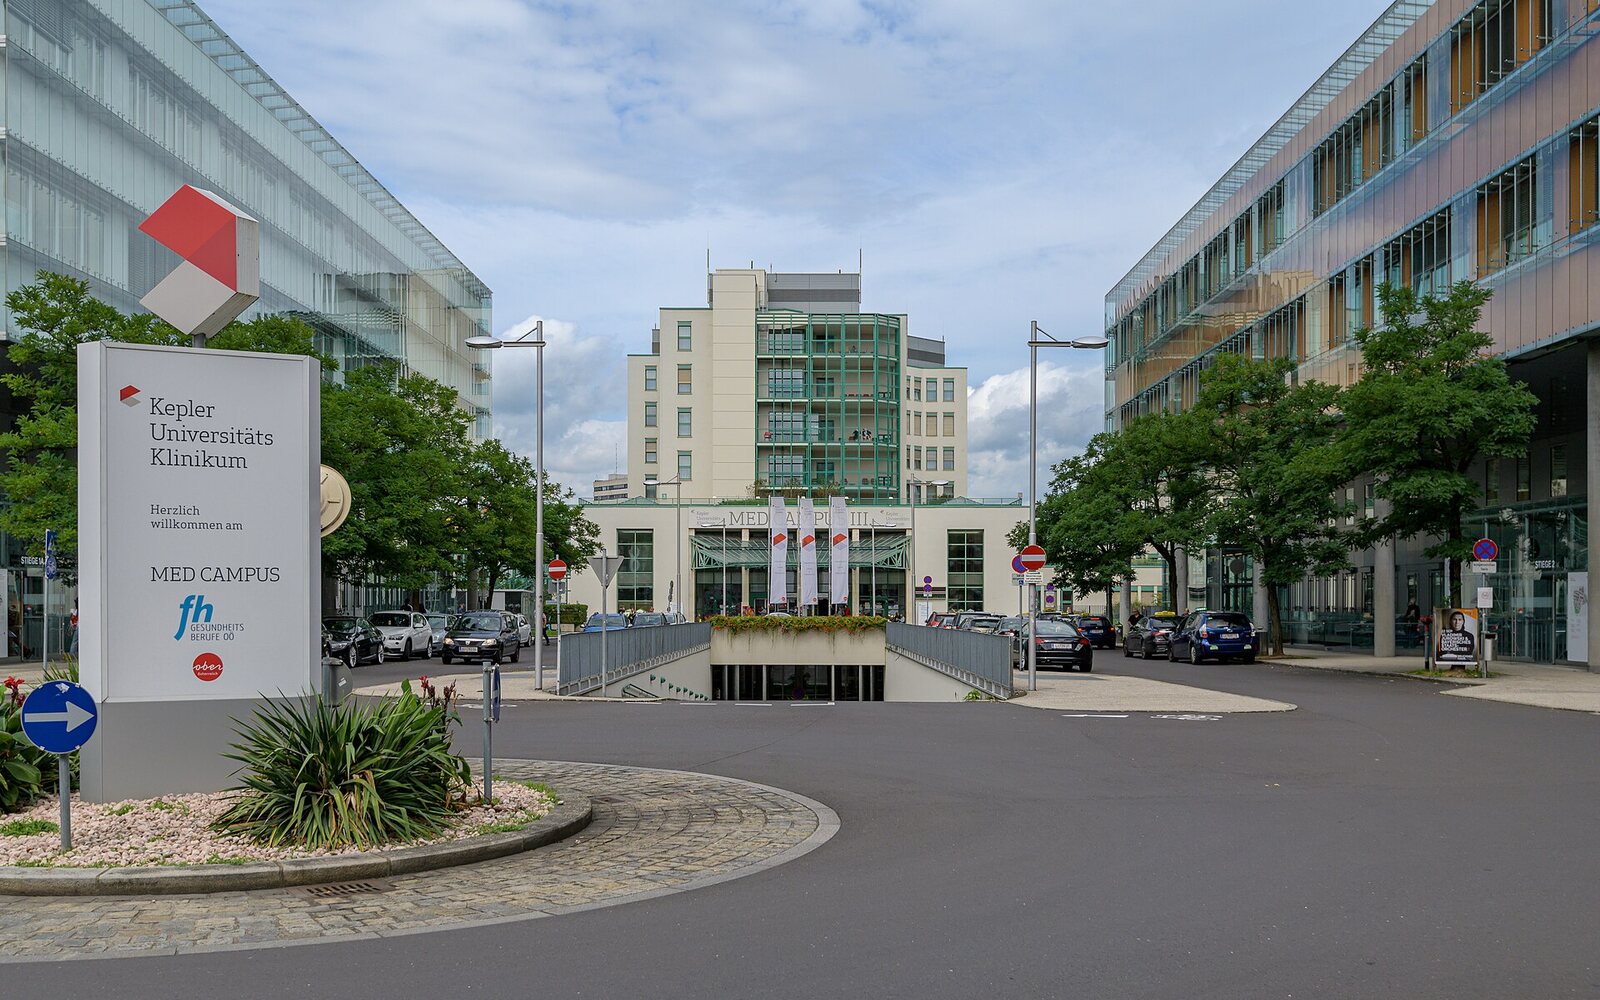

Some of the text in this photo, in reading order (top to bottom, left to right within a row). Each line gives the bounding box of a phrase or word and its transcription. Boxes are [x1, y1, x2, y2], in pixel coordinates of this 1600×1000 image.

[150, 397, 215, 421] Kepler
[150, 423, 274, 446] Universitäts
[150, 448, 248, 469] Klinikum
[150, 504, 200, 516] Herzlich
[150, 519, 243, 531] willkommen am
[729, 511, 769, 526] MED
[772, 511, 847, 526] APU
[850, 511, 869, 526] III
[1535, 560, 1556, 569] STIEGE 2
[150, 567, 281, 582] MED CAMPUS
[174, 594, 214, 641] fh
[190, 623, 245, 632] GESUNDHEITS
[190, 633, 220, 641] BERUFE
